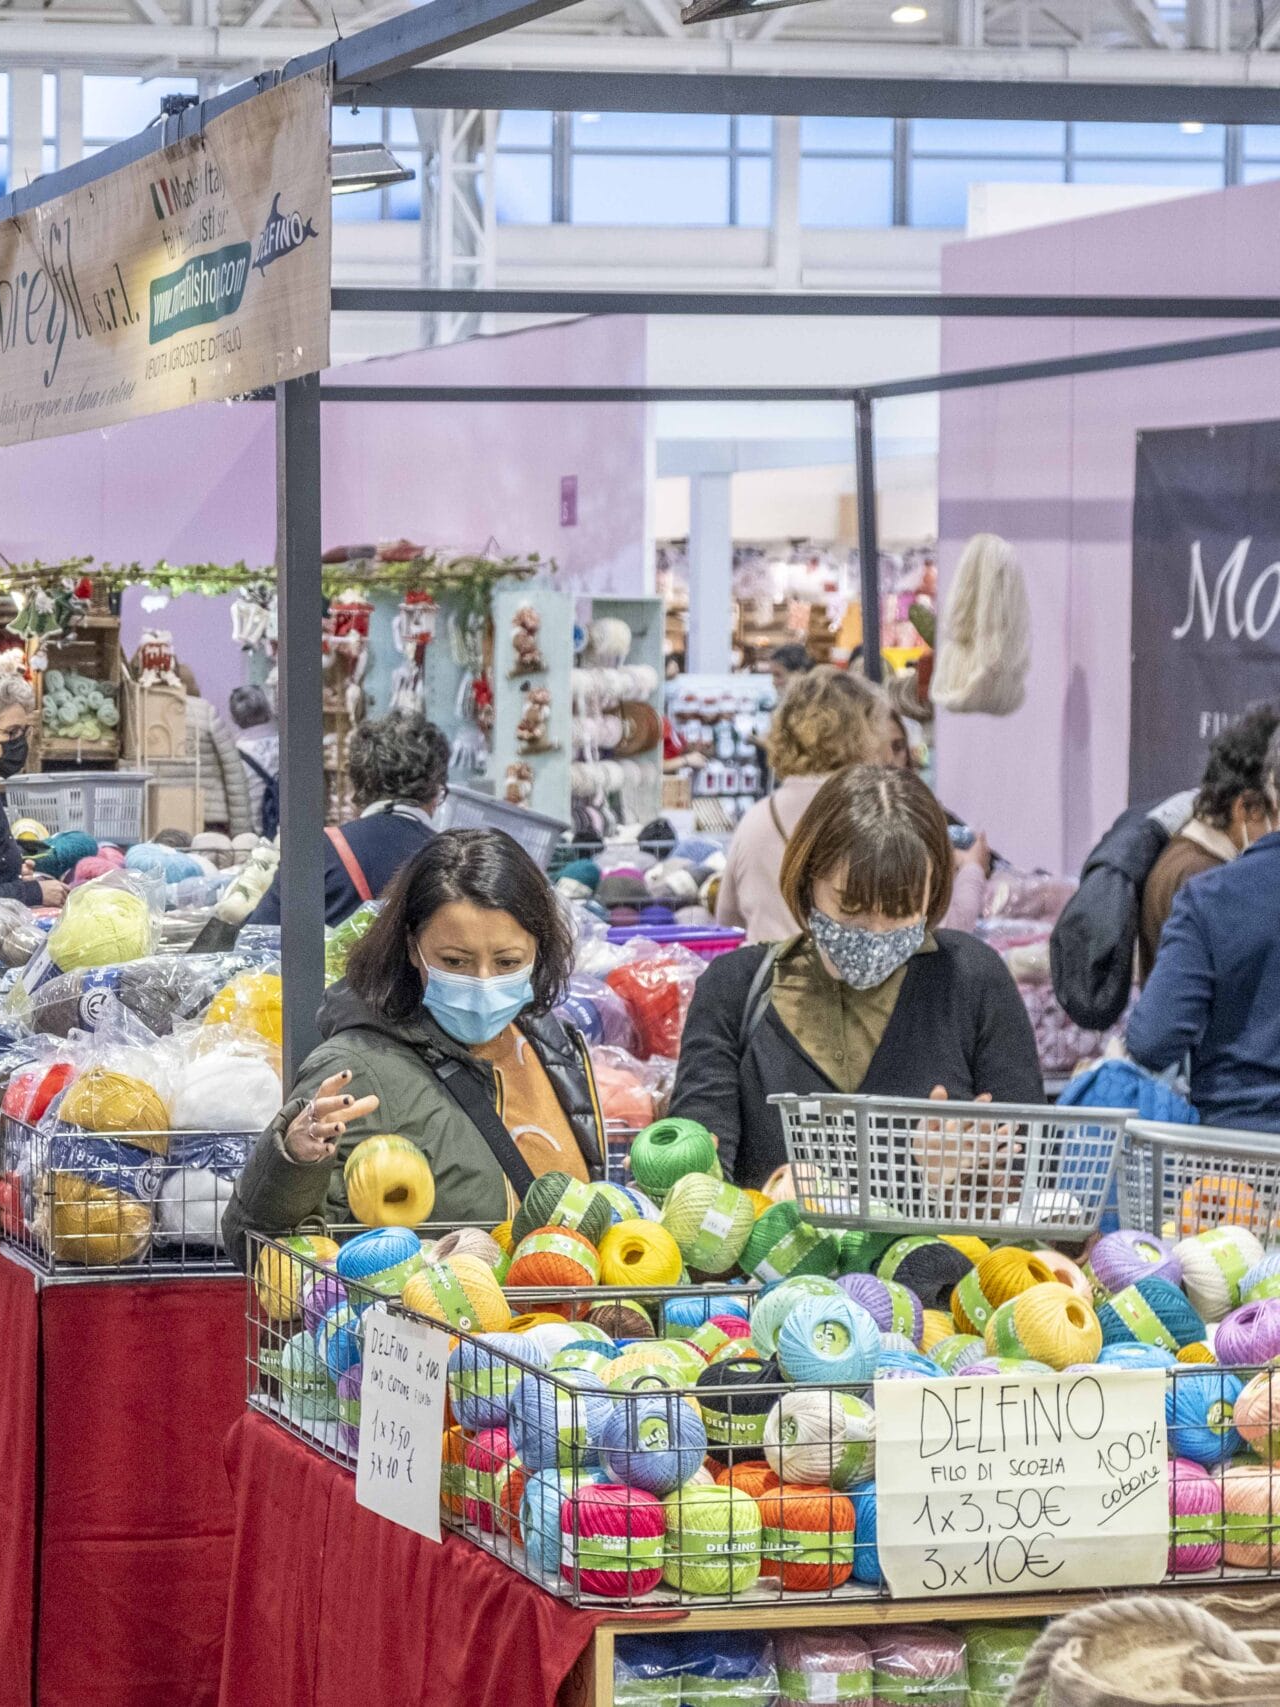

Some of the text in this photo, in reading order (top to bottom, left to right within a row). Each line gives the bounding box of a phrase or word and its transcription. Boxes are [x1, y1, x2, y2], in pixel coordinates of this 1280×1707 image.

[204, 160, 226, 199] Itay
[93, 262, 140, 336] s.r.l.
[371, 1327, 409, 1363] DELFINO
[920, 1375, 1105, 1459] DELFINO
[931, 1458, 1066, 1483] FILO DI SCOZIA
[1097, 1421, 1161, 1478] 100%
